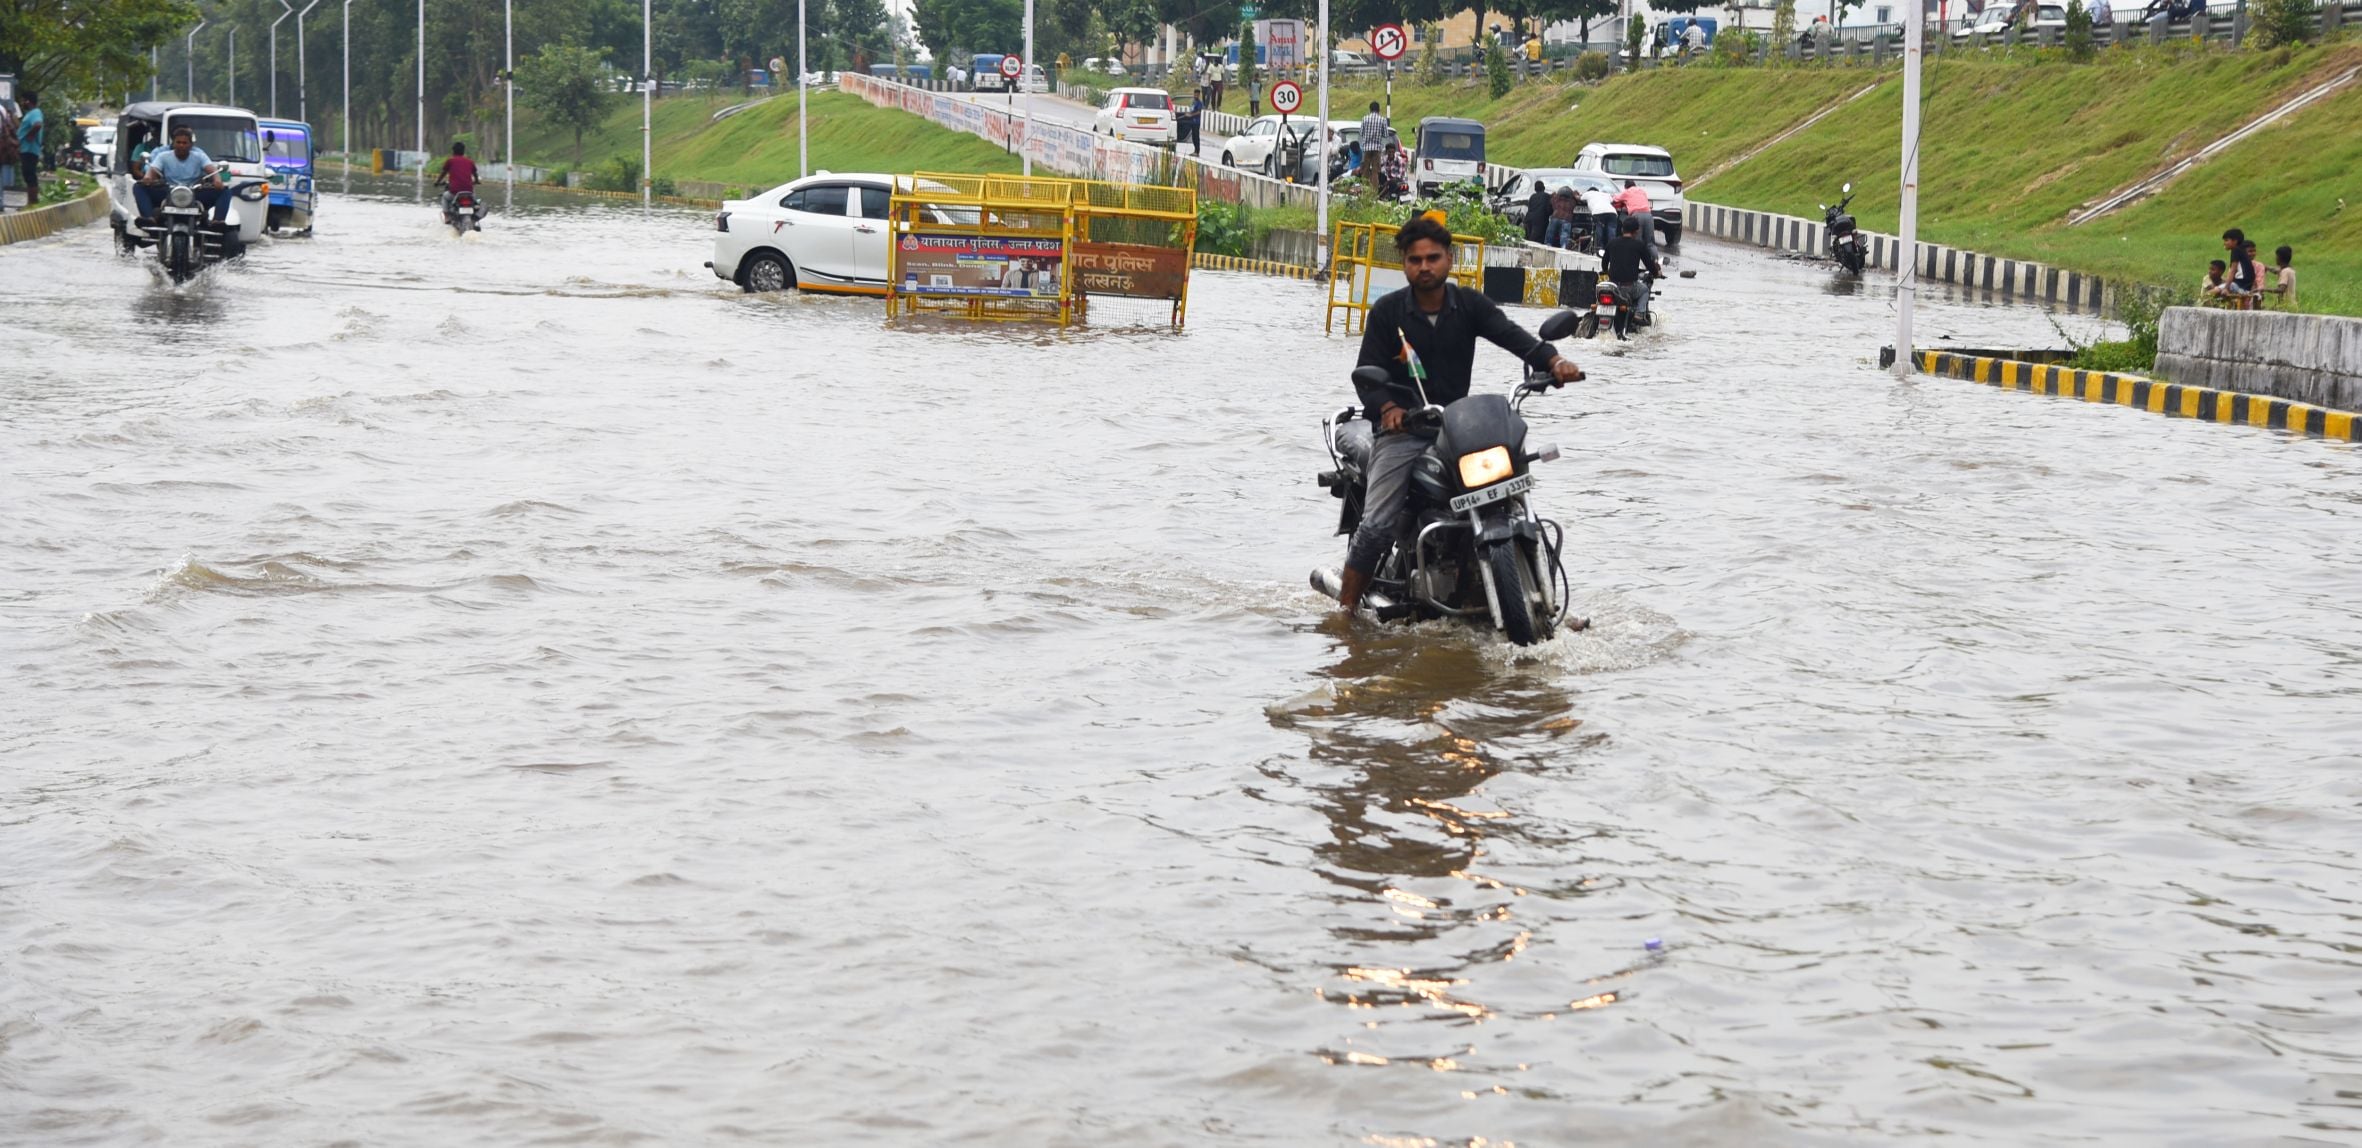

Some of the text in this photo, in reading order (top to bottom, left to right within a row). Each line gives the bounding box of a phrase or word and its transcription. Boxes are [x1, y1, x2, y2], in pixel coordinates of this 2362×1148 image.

[1269, 33, 1297, 45] Amul
[1277, 90, 1296, 104] 30
[920, 236, 967, 249] यातायात
[1035, 238, 1061, 251] प्रदेश
[1102, 252, 1156, 273] पुलिस
[1083, 273, 1135, 290] लखनऊ
[1487, 489, 1498, 500] EF
[1511, 477, 1531, 492] 3376
